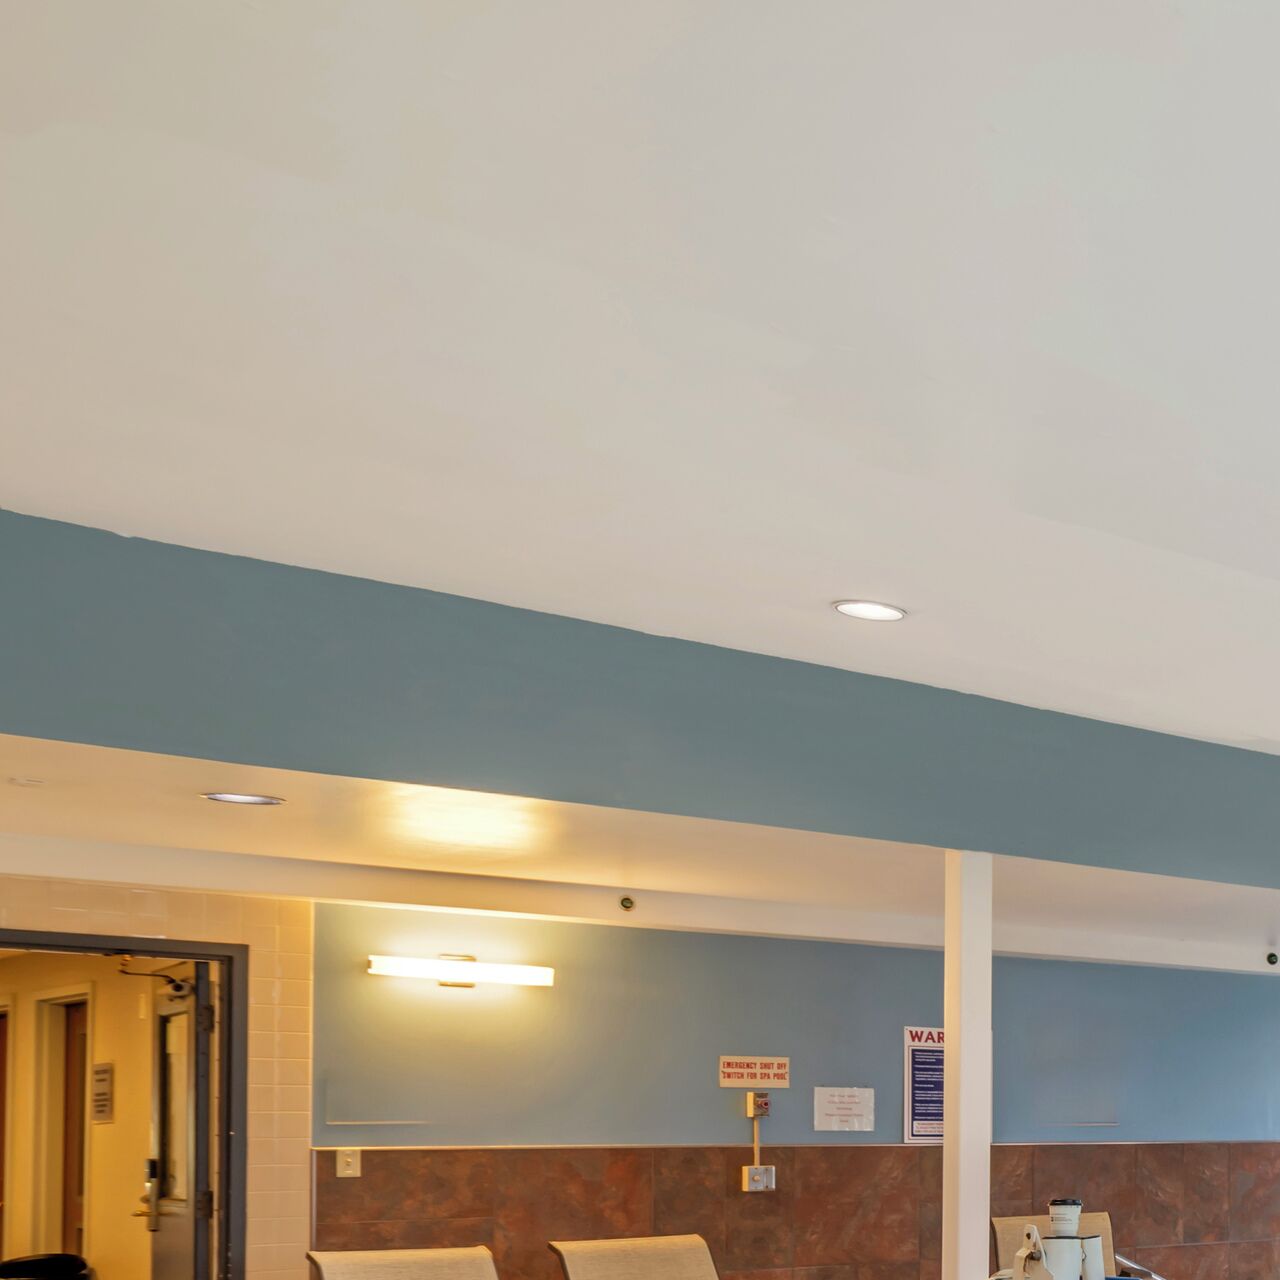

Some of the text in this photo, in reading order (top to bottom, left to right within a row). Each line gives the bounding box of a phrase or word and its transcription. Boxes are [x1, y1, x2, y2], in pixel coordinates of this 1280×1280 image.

[760, 1062, 774, 1070] SHUT
[777, 1062, 787, 1070] OFF
[760, 1072, 770, 1080] SPA
